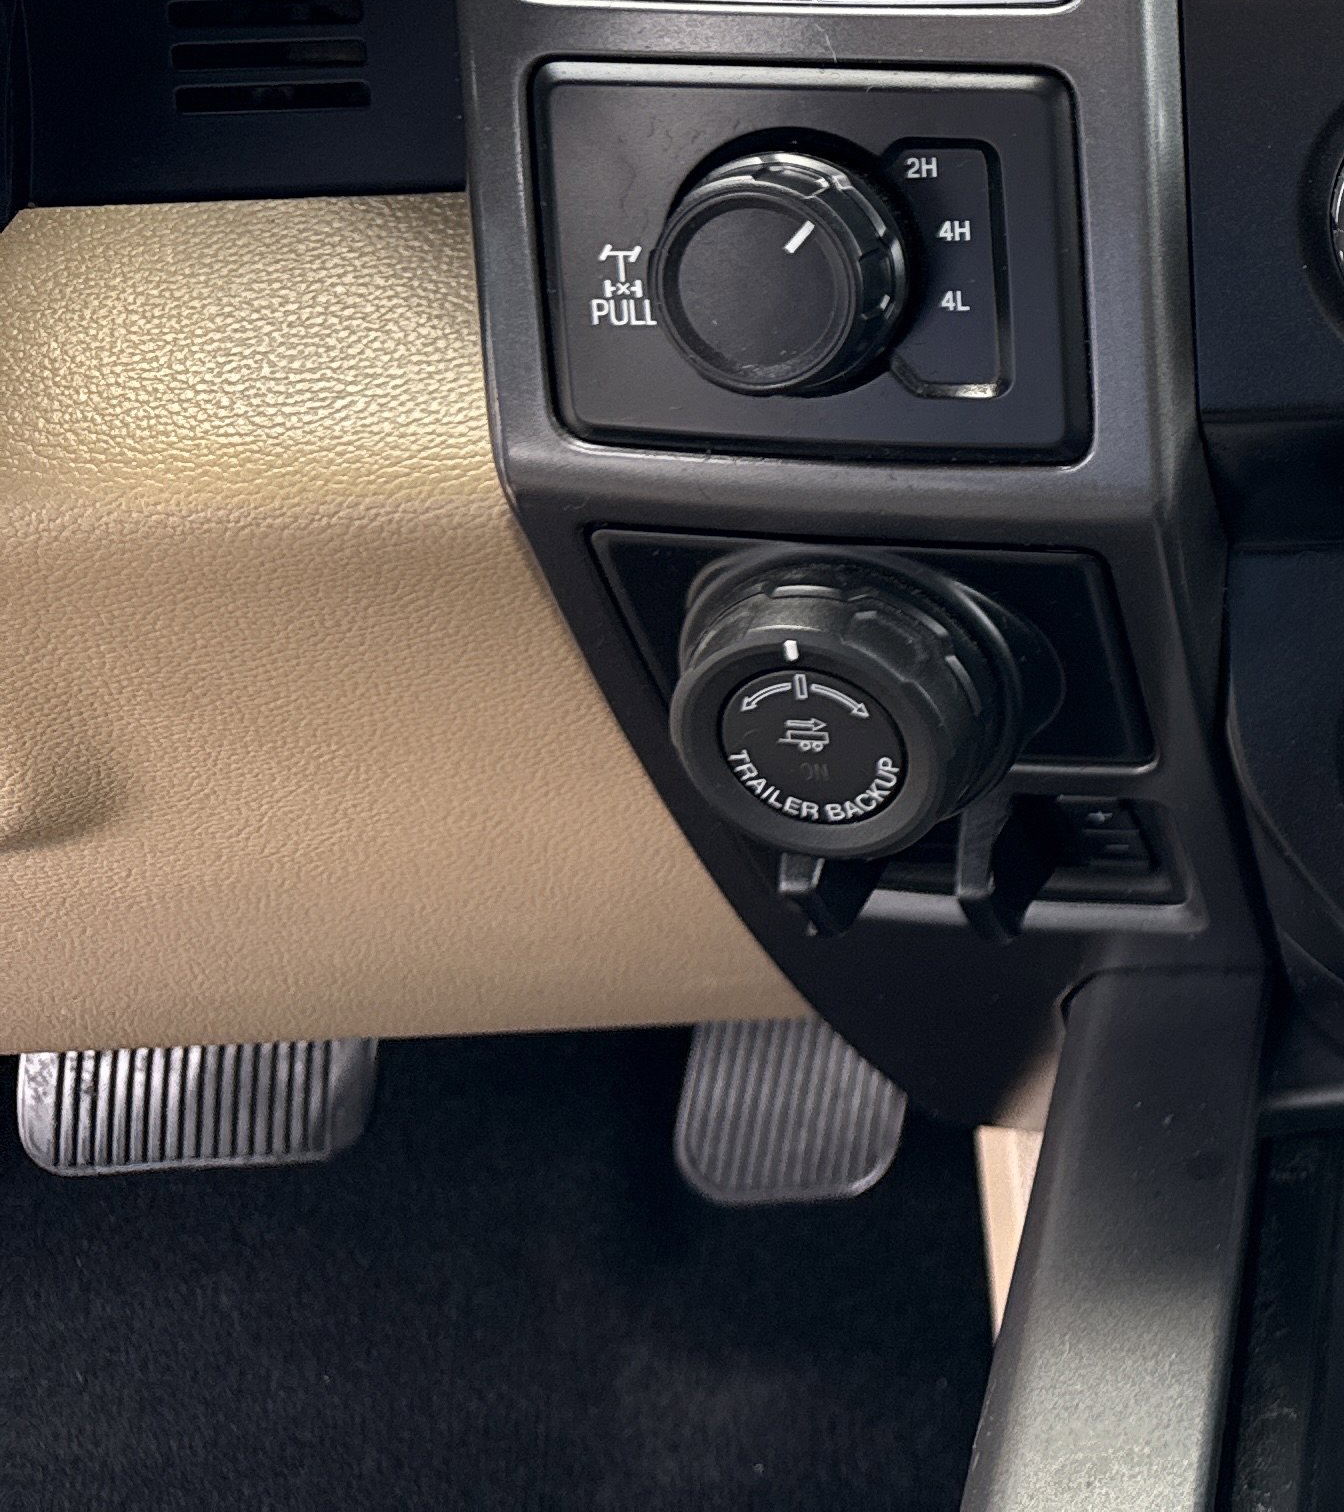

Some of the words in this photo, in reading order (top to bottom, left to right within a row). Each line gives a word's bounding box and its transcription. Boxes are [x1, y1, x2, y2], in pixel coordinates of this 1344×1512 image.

[906, 158, 938, 179] 2H
[939, 221, 970, 242] 4H
[941, 290, 970, 312] 4L
[591, 299, 657, 326] PULL
[727, 749, 820, 821] TRAILER
[823, 756, 900, 822] BACKUP
